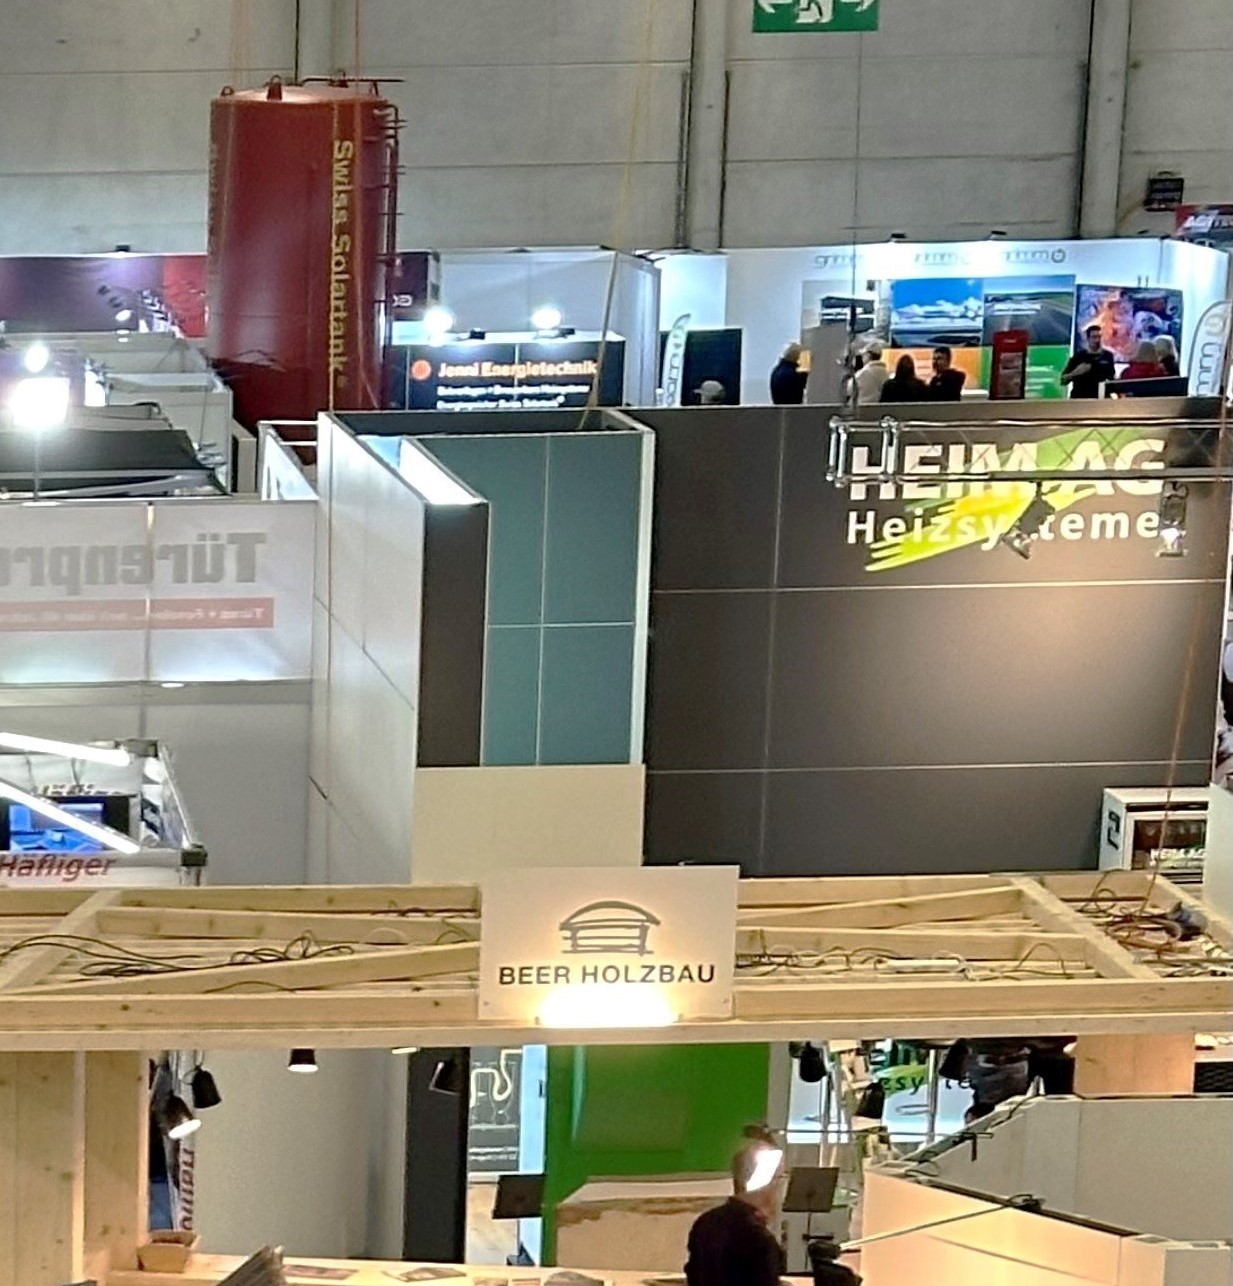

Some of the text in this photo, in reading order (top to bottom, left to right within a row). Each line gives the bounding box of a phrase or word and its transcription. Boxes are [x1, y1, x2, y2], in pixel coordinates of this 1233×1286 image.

[850, 439, 1166, 500] HEIM AG
[847, 509, 1162, 551] Heizsyteme
[499, 964, 715, 985] BEER HOLZBAU
